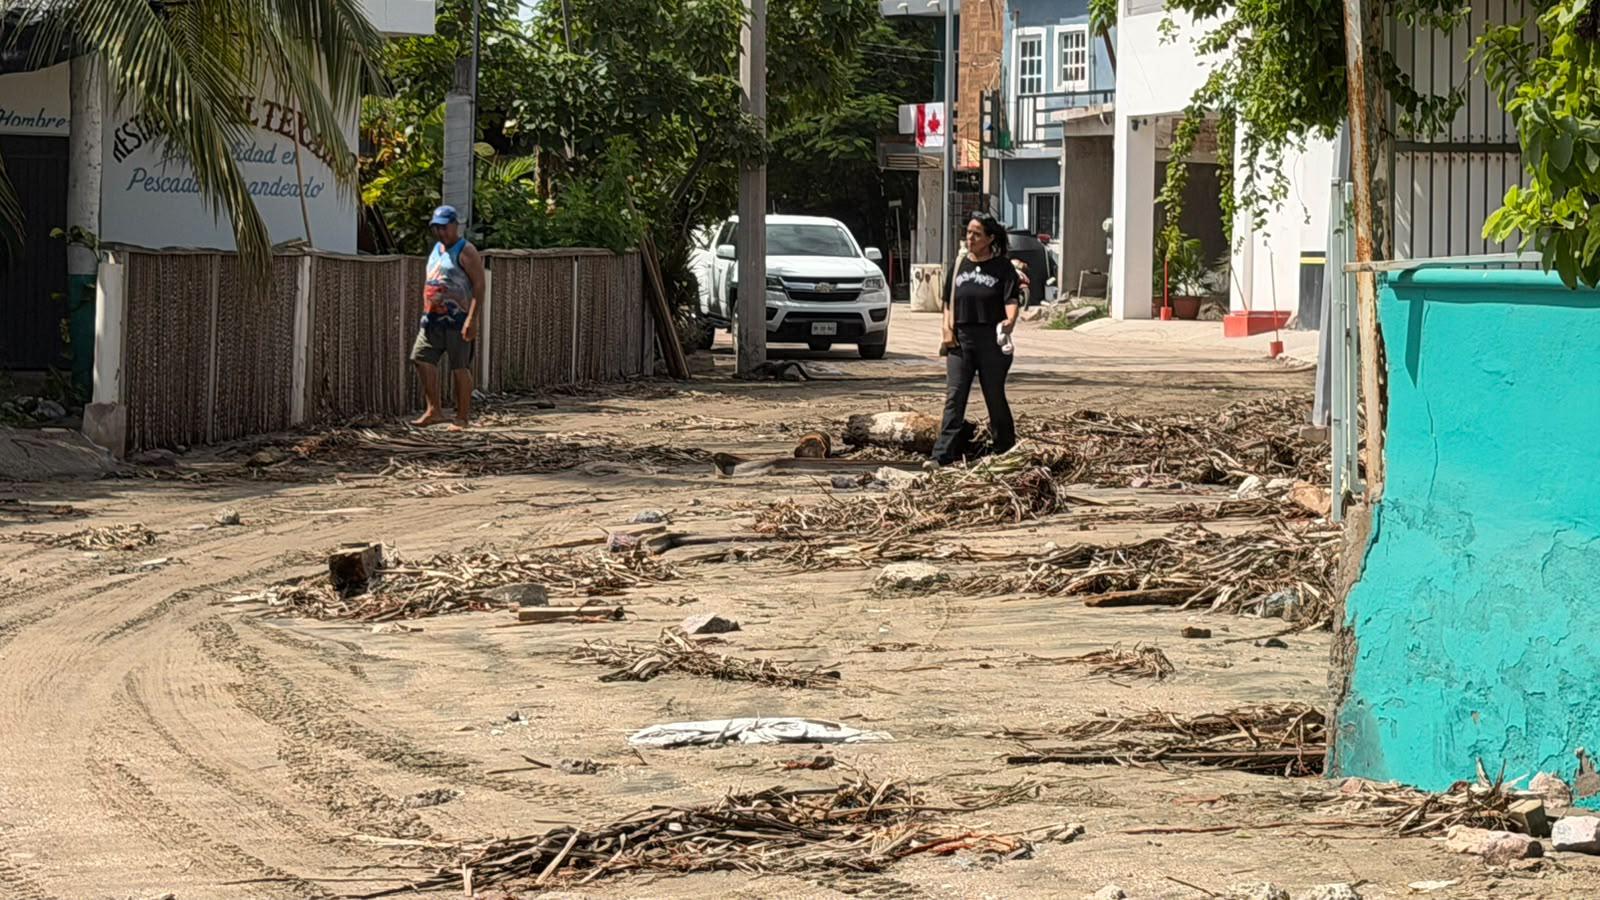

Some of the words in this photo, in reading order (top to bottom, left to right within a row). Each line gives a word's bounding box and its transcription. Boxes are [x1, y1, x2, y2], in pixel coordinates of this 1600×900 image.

[0, 107, 71, 128] Hombre
[126, 167, 201, 193] Pesca
[248, 176, 325, 198] andeado
